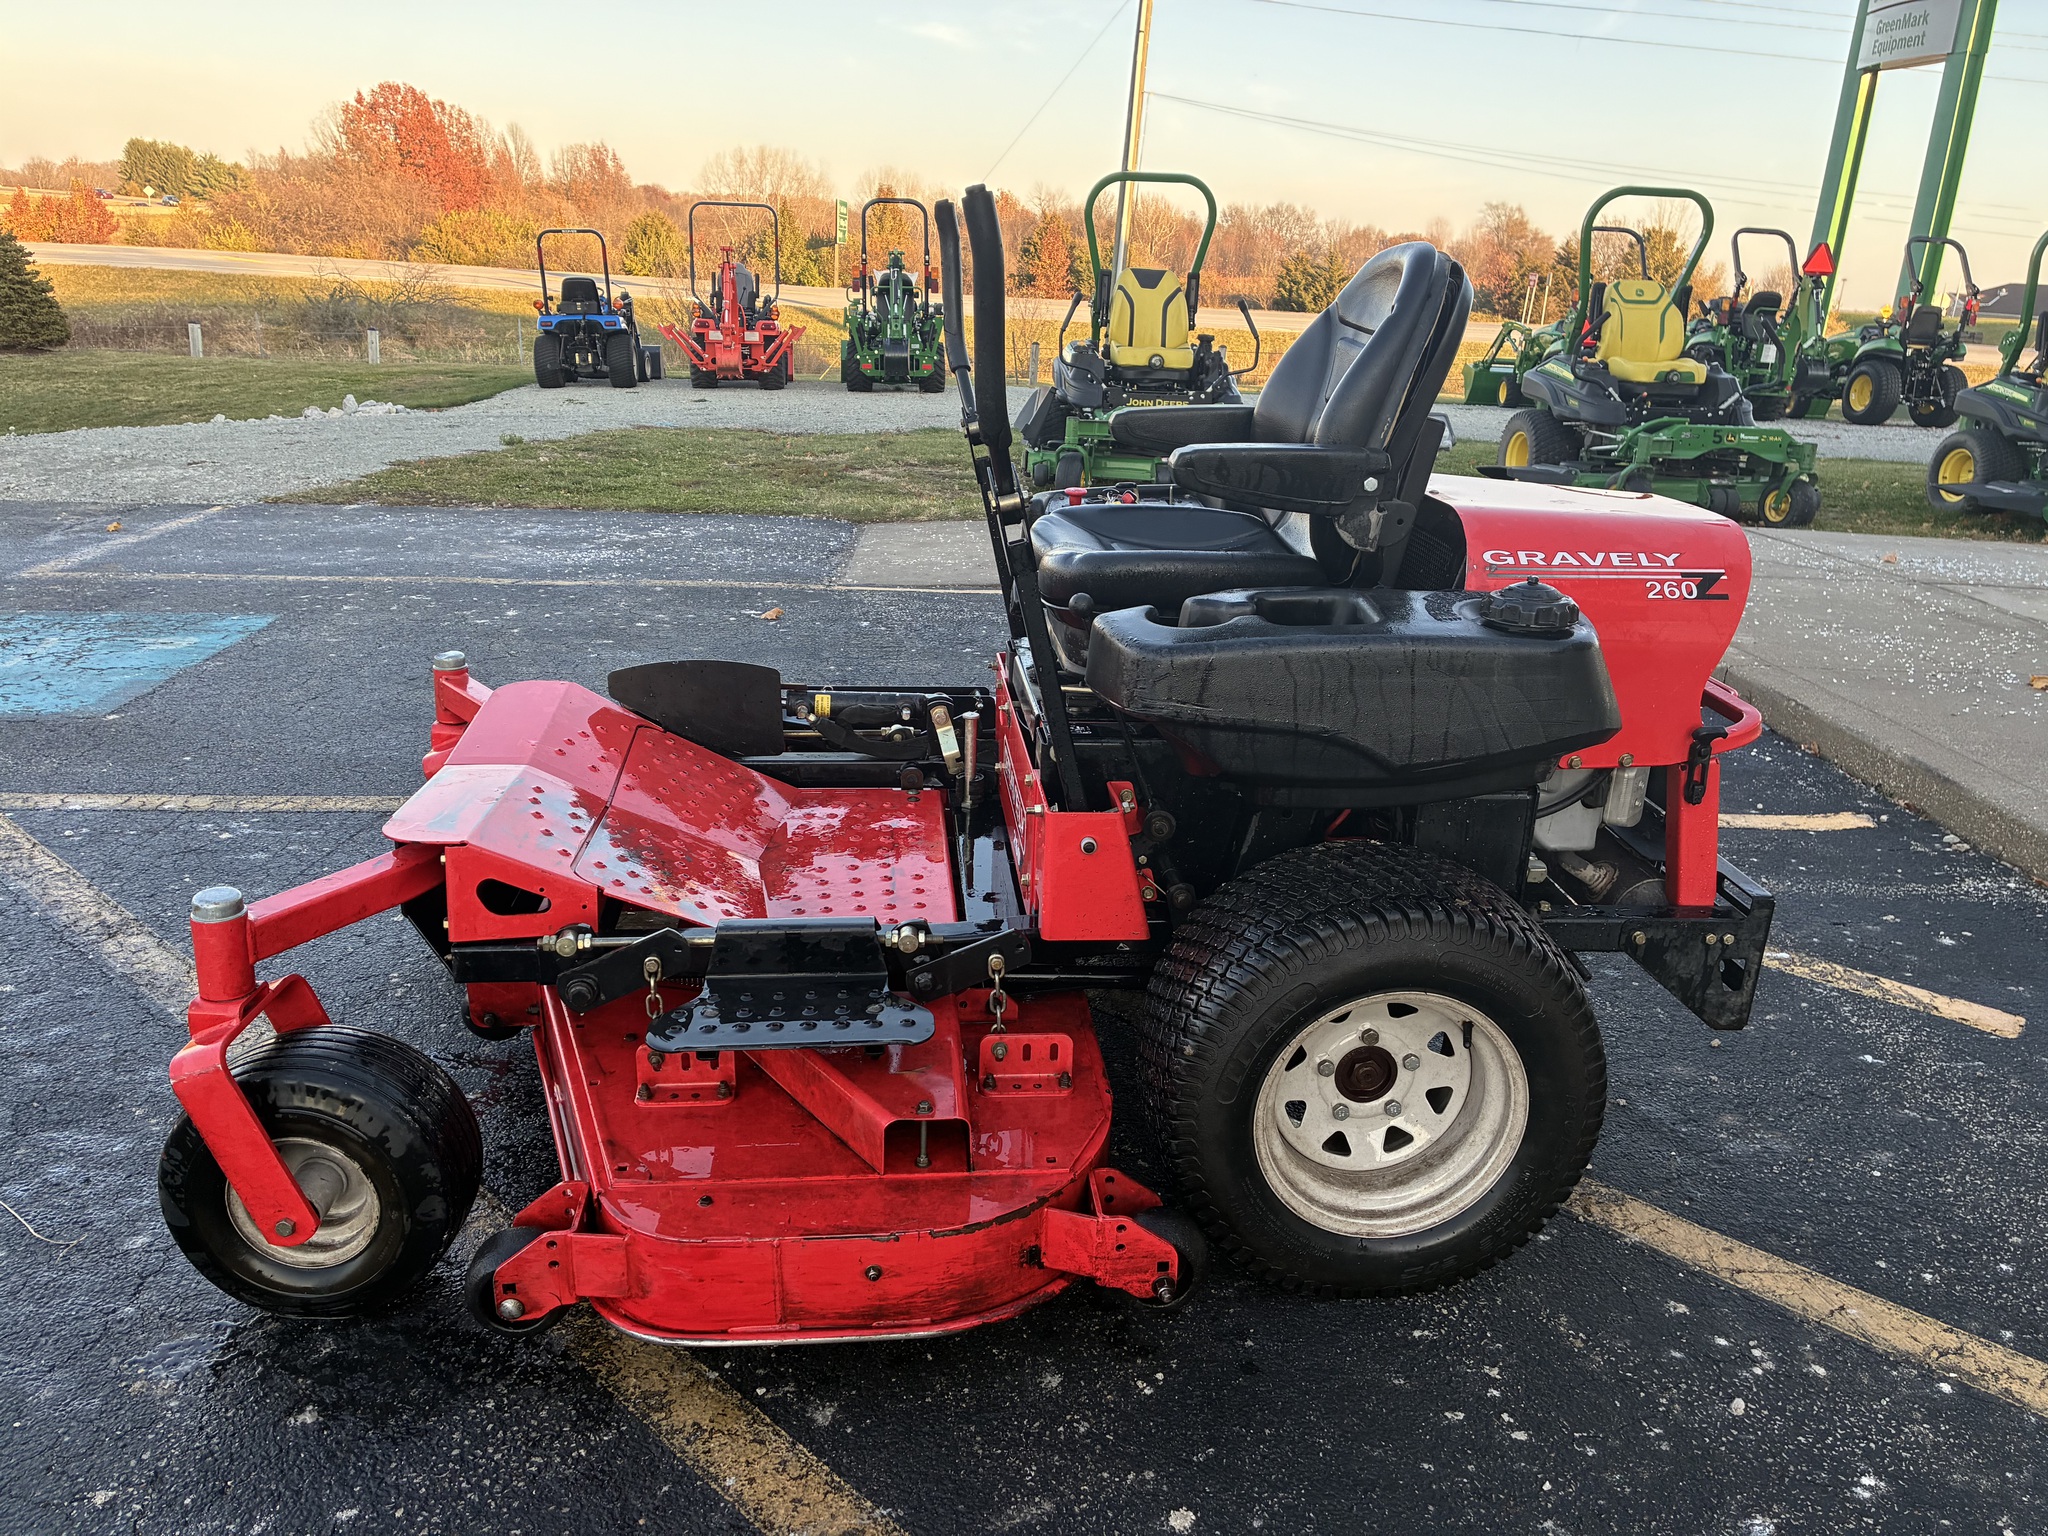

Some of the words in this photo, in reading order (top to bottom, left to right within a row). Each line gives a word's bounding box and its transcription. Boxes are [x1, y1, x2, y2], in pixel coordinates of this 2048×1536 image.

[1876, 9, 1930, 35] GreenMark
[1871, 31, 1926, 57] Equipment
[1126, 397, 1154, 407] JOHN
[1481, 550, 1682, 567] GRAVELY
